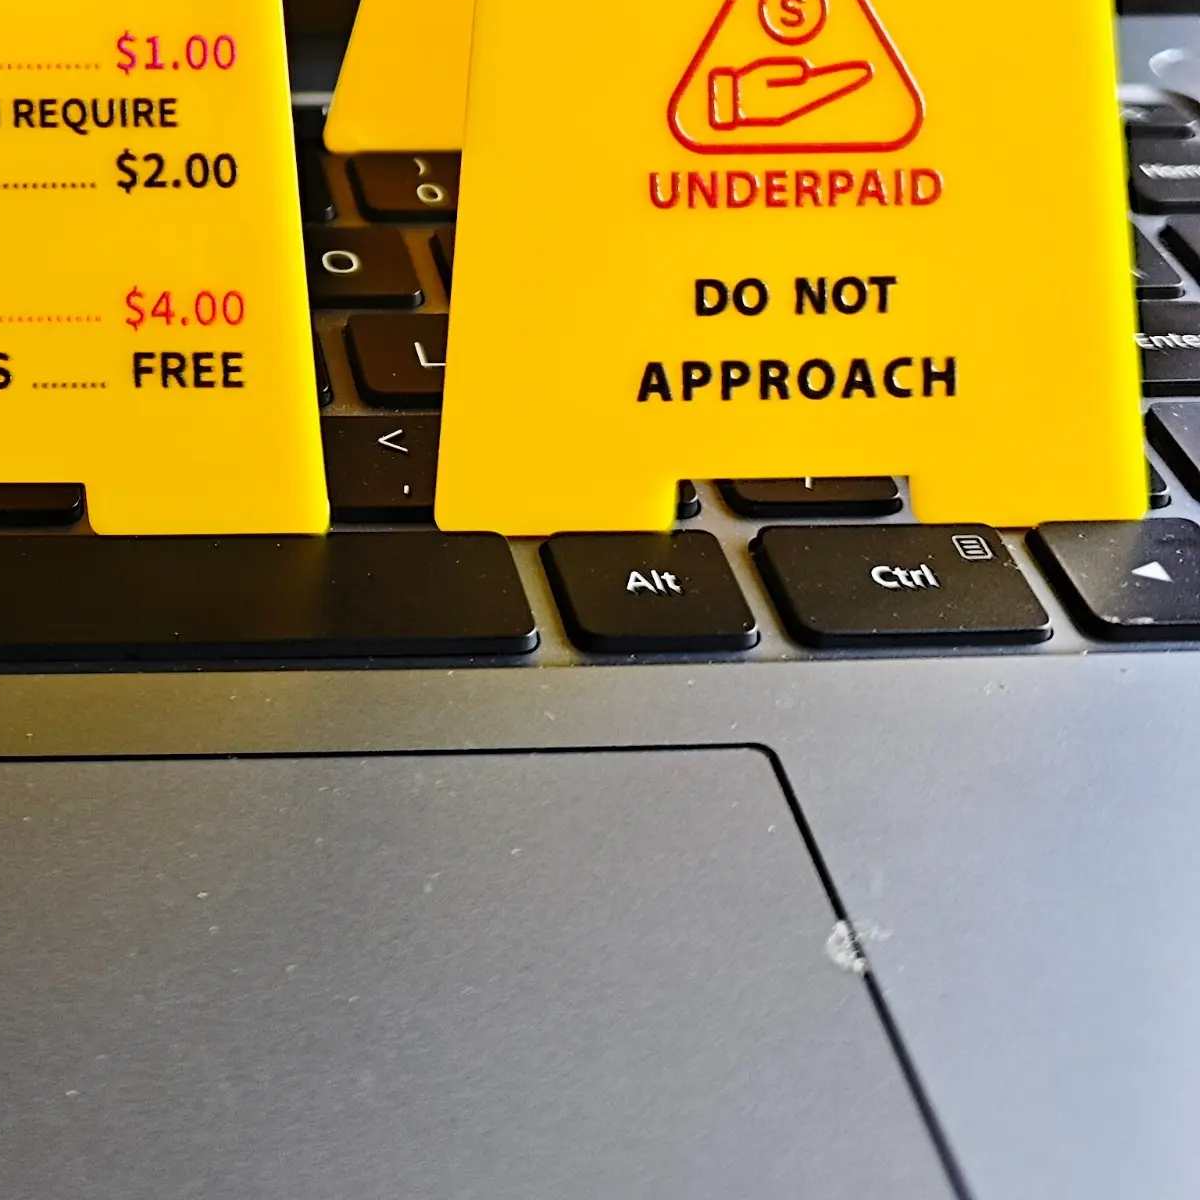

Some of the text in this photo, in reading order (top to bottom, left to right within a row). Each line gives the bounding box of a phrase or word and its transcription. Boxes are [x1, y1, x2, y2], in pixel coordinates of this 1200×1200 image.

[116, 31, 237, 76] $1.00
[13, 98, 178, 135] REQUIRE
[116, 148, 238, 194] $2.00
[649, 169, 943, 210] UNDERPAID
[125, 286, 245, 331] $4.00
[695, 276, 897, 316] DO NOT
[1134, 332, 1200, 350] Ente
[133, 352, 245, 388] FREE
[637, 357, 955, 402] APPROACH
[626, 569, 683, 596] Alt
[871, 563, 941, 590] Ctrl
